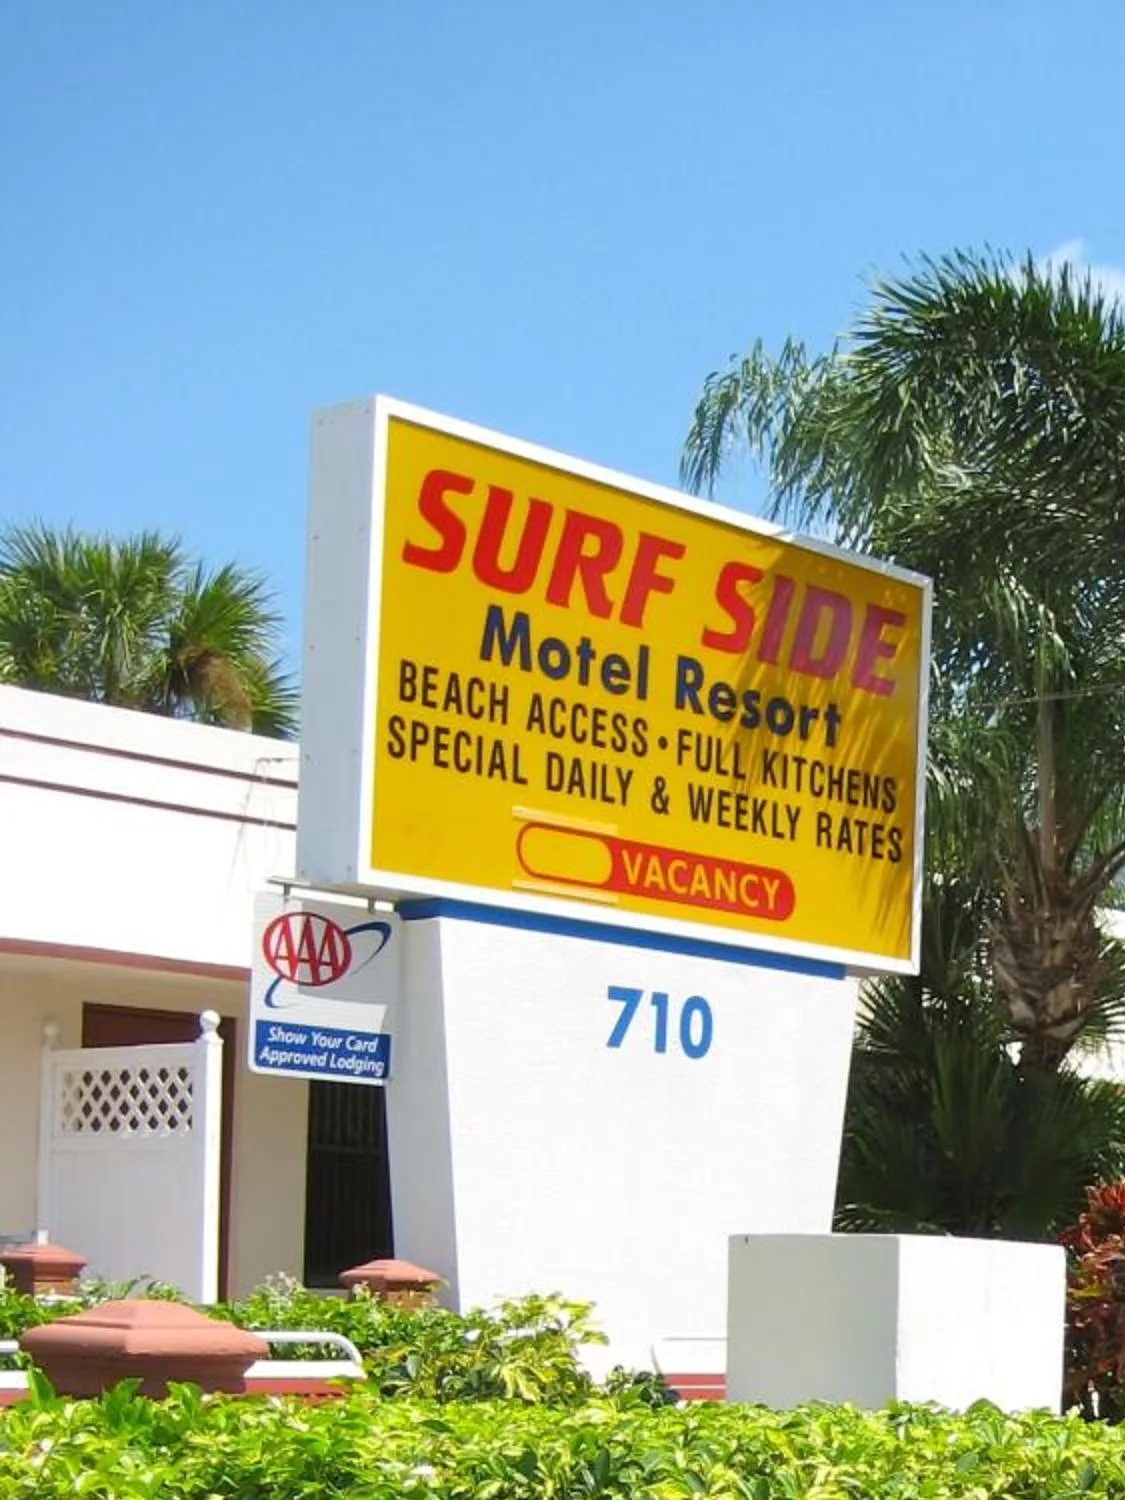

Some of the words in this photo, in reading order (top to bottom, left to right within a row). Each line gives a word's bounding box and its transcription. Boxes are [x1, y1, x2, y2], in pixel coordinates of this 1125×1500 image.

[401, 468, 687, 629] SURF
[701, 561, 908, 698] SIDE
[479, 604, 650, 700] Motel
[674, 654, 842, 748] Resort
[398, 659, 509, 725] BEACH
[526, 692, 649, 758] ACCESS
[676, 729, 747, 782] FULL
[762, 756, 898, 813] KITCHENS
[387, 715, 529, 785] SPECIAL
[545, 751, 635, 807] DAILY
[650, 776, 671, 816] &
[687, 783, 802, 842] WEEKLY
[816, 811, 904, 864] RATES
[621, 849, 782, 913] VACANCY
[271, 914, 343, 986] AAA
[267, 1026, 307, 1044] Show
[311, 1031, 343, 1048] Your
[345, 1035, 379, 1053] Card
[606, 985, 713, 1060] 710
[259, 1046, 328, 1067] Approved
[329, 1054, 385, 1077] Lodging
